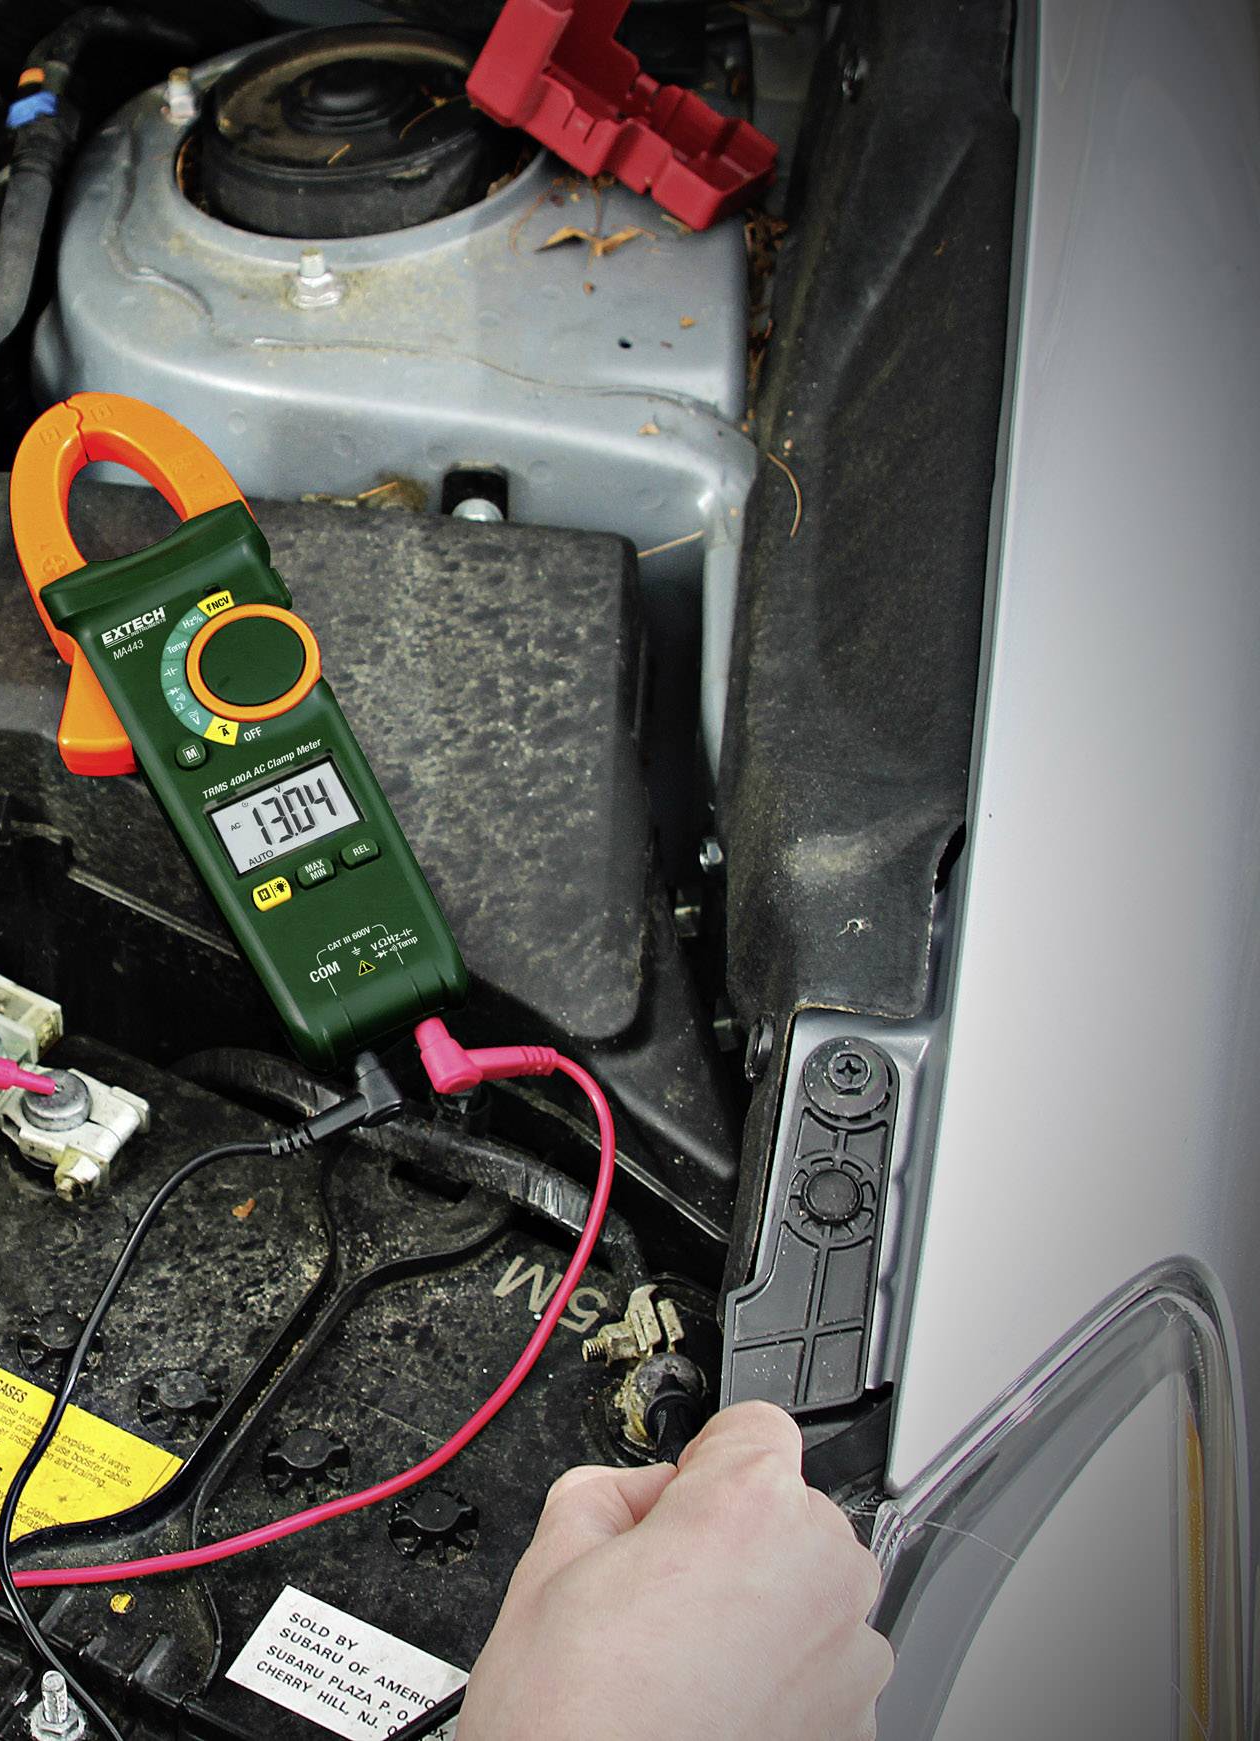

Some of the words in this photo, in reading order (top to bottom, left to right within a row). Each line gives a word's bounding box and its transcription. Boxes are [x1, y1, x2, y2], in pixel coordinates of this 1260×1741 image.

[211, 595, 229, 609] NCV
[101, 606, 166, 645] EXTECH
[182, 614, 204, 629] Hz%
[113, 639, 144, 660] MA443
[166, 639, 188, 654] Temp
[243, 726, 262, 742] OFF
[185, 749, 198, 760] M
[202, 781, 229, 800] TRMS
[230, 771, 253, 787] 400A
[253, 763, 266, 776] AC
[267, 751, 295, 770] Clamp
[296, 738, 322, 757] Meter
[273, 785, 281, 793] V
[230, 822, 242, 831] AC
[252, 777, 337, 846] 13.04
[248, 850, 274, 867] AUTO
[352, 843, 370, 857] REL
[304, 859, 325, 873] MAX
[309, 868, 328, 881] MIN
[327, 939, 342, 952] CAT
[342, 935, 352, 944] III
[351, 926, 372, 940] 600V
[397, 936, 419, 949] Temp
[309, 961, 341, 983] COM
[493, 1256, 608, 1334] 5M
[289, 1612, 330, 1638] SOLD
[335, 1634, 360, 1651] BY
[279, 1627, 344, 1665] SUBARU
[348, 1660, 370, 1677] OF
[374, 1676, 437, 1711] AMERIC
[266, 1645, 325, 1681] SUBARU
[328, 1675, 373, 1705] PLAZA
[378, 1700, 391, 1714] P.
[256, 1660, 313, 1693] CHERRY
[317, 1690, 350, 1716] HILL,
[357, 1710, 378, 1730] NJ.
